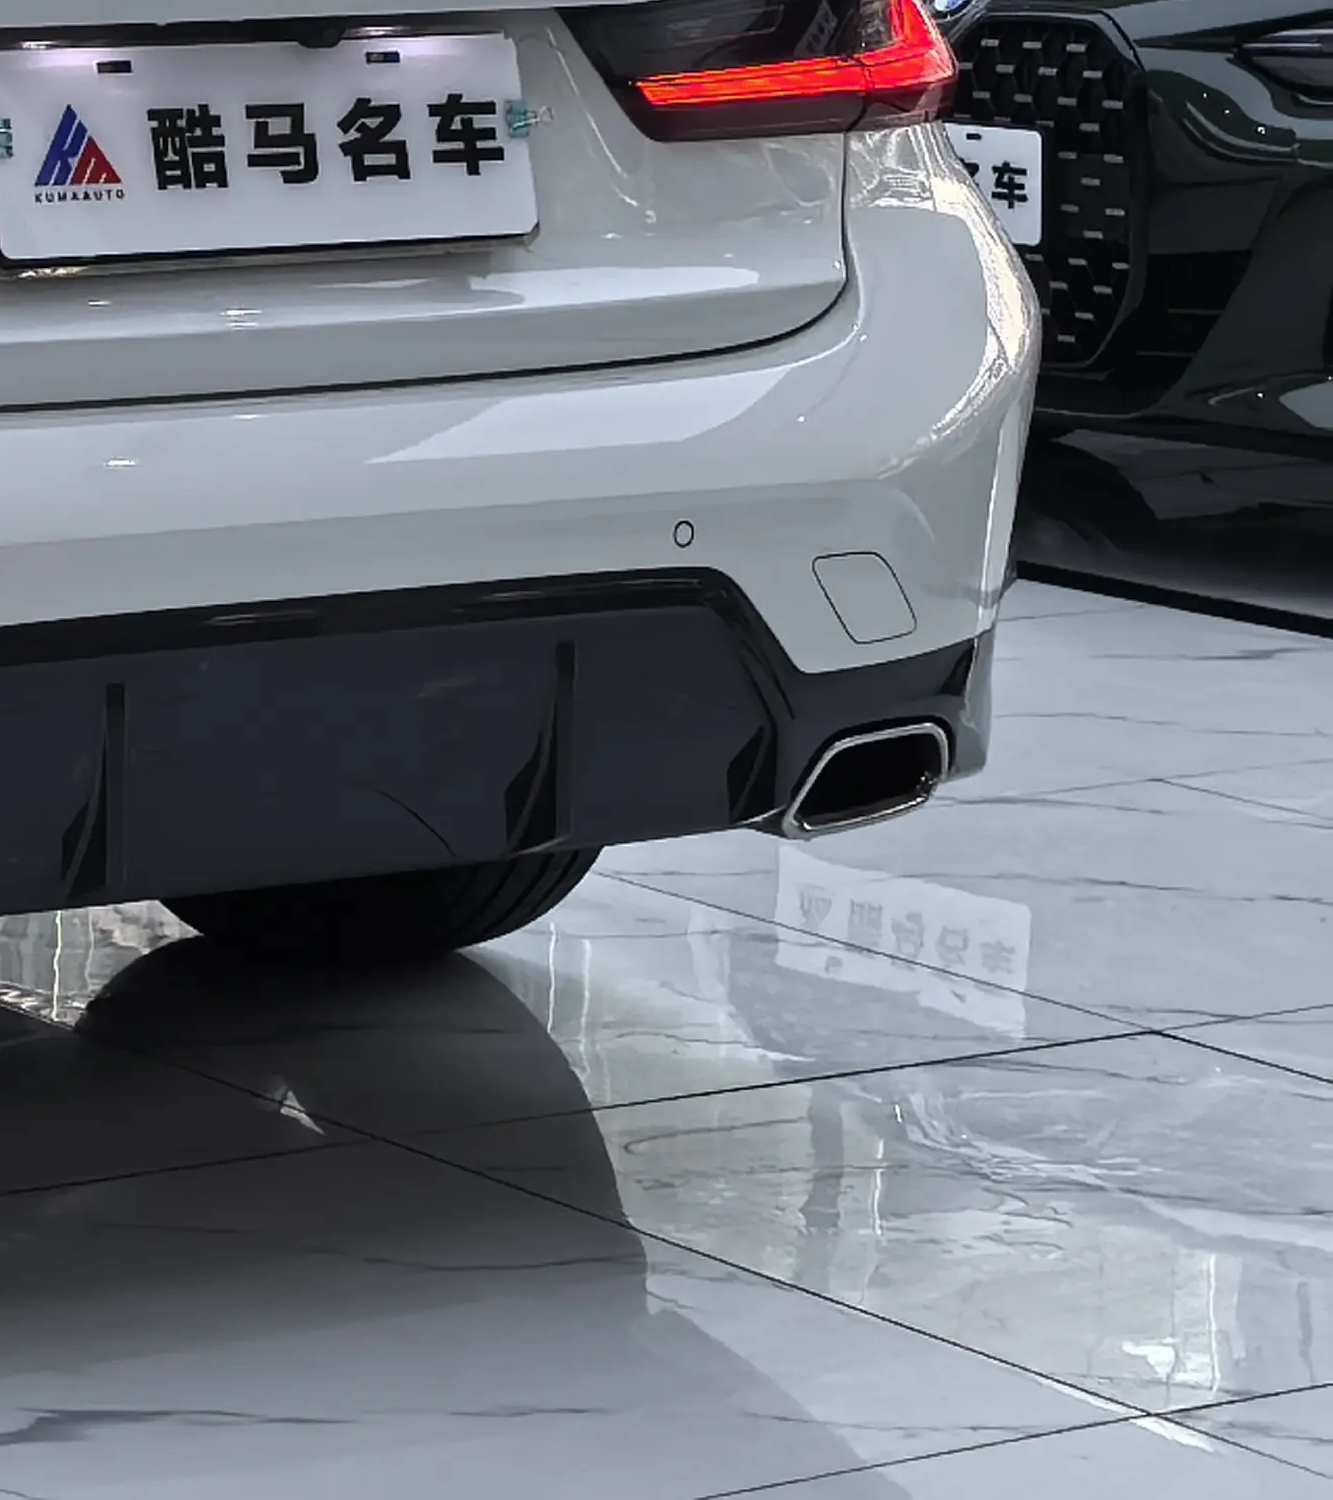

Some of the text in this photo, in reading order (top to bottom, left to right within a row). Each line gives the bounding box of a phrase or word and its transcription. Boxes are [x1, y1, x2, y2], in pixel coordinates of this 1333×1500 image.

[146, 93, 506, 190] 酷马名车
[34, 189, 126, 204] KUMAAUTO
